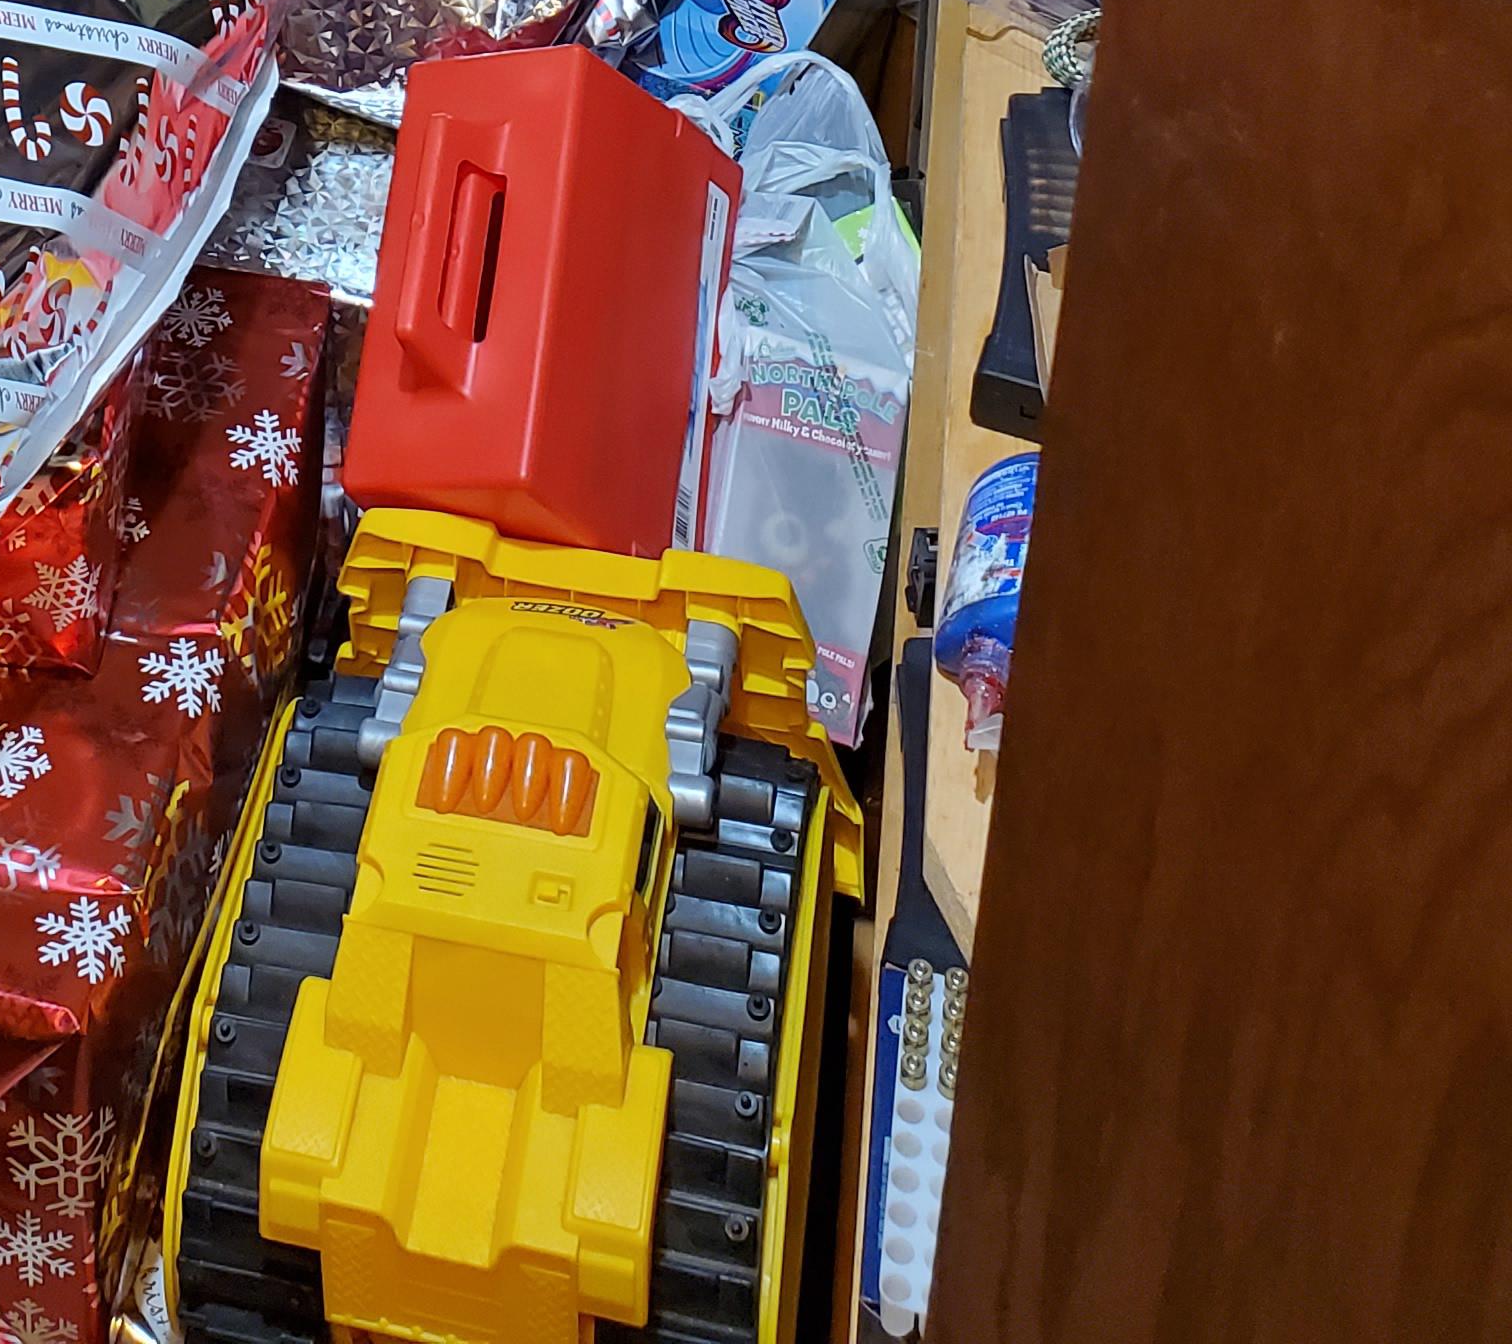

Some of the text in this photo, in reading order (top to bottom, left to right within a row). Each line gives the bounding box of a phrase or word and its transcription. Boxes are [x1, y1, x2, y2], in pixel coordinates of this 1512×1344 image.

[43, 18, 129, 53] christmas
[136, 35, 180, 64] MERRY
[7, 190, 64, 217] MERRY
[781, 389, 861, 435] PALS
[841, 378, 900, 425] POLE
[512, 601, 603, 619] DOZER
